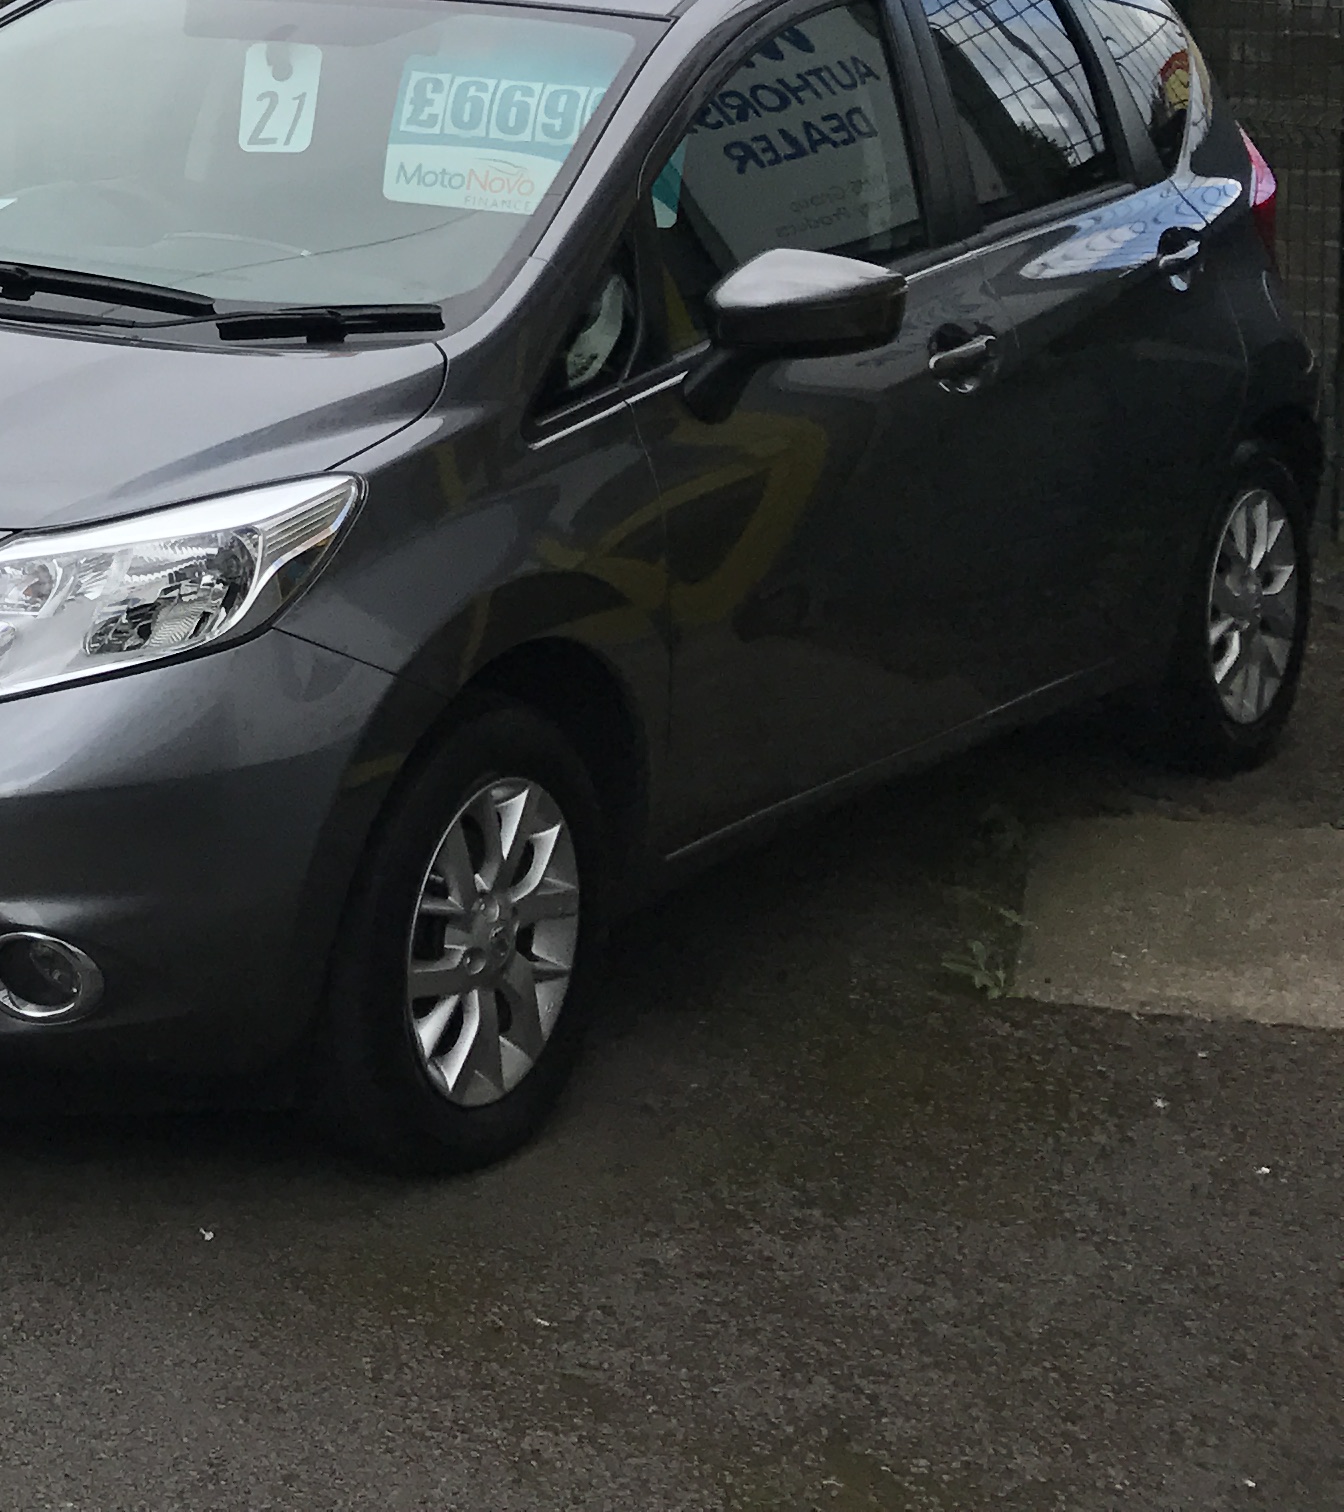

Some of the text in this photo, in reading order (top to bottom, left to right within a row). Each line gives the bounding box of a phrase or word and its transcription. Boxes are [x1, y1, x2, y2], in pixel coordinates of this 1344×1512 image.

[252, 90, 308, 148] 21
[395, 161, 535, 197] MotoNovo
[464, 195, 531, 213] FINANCE
